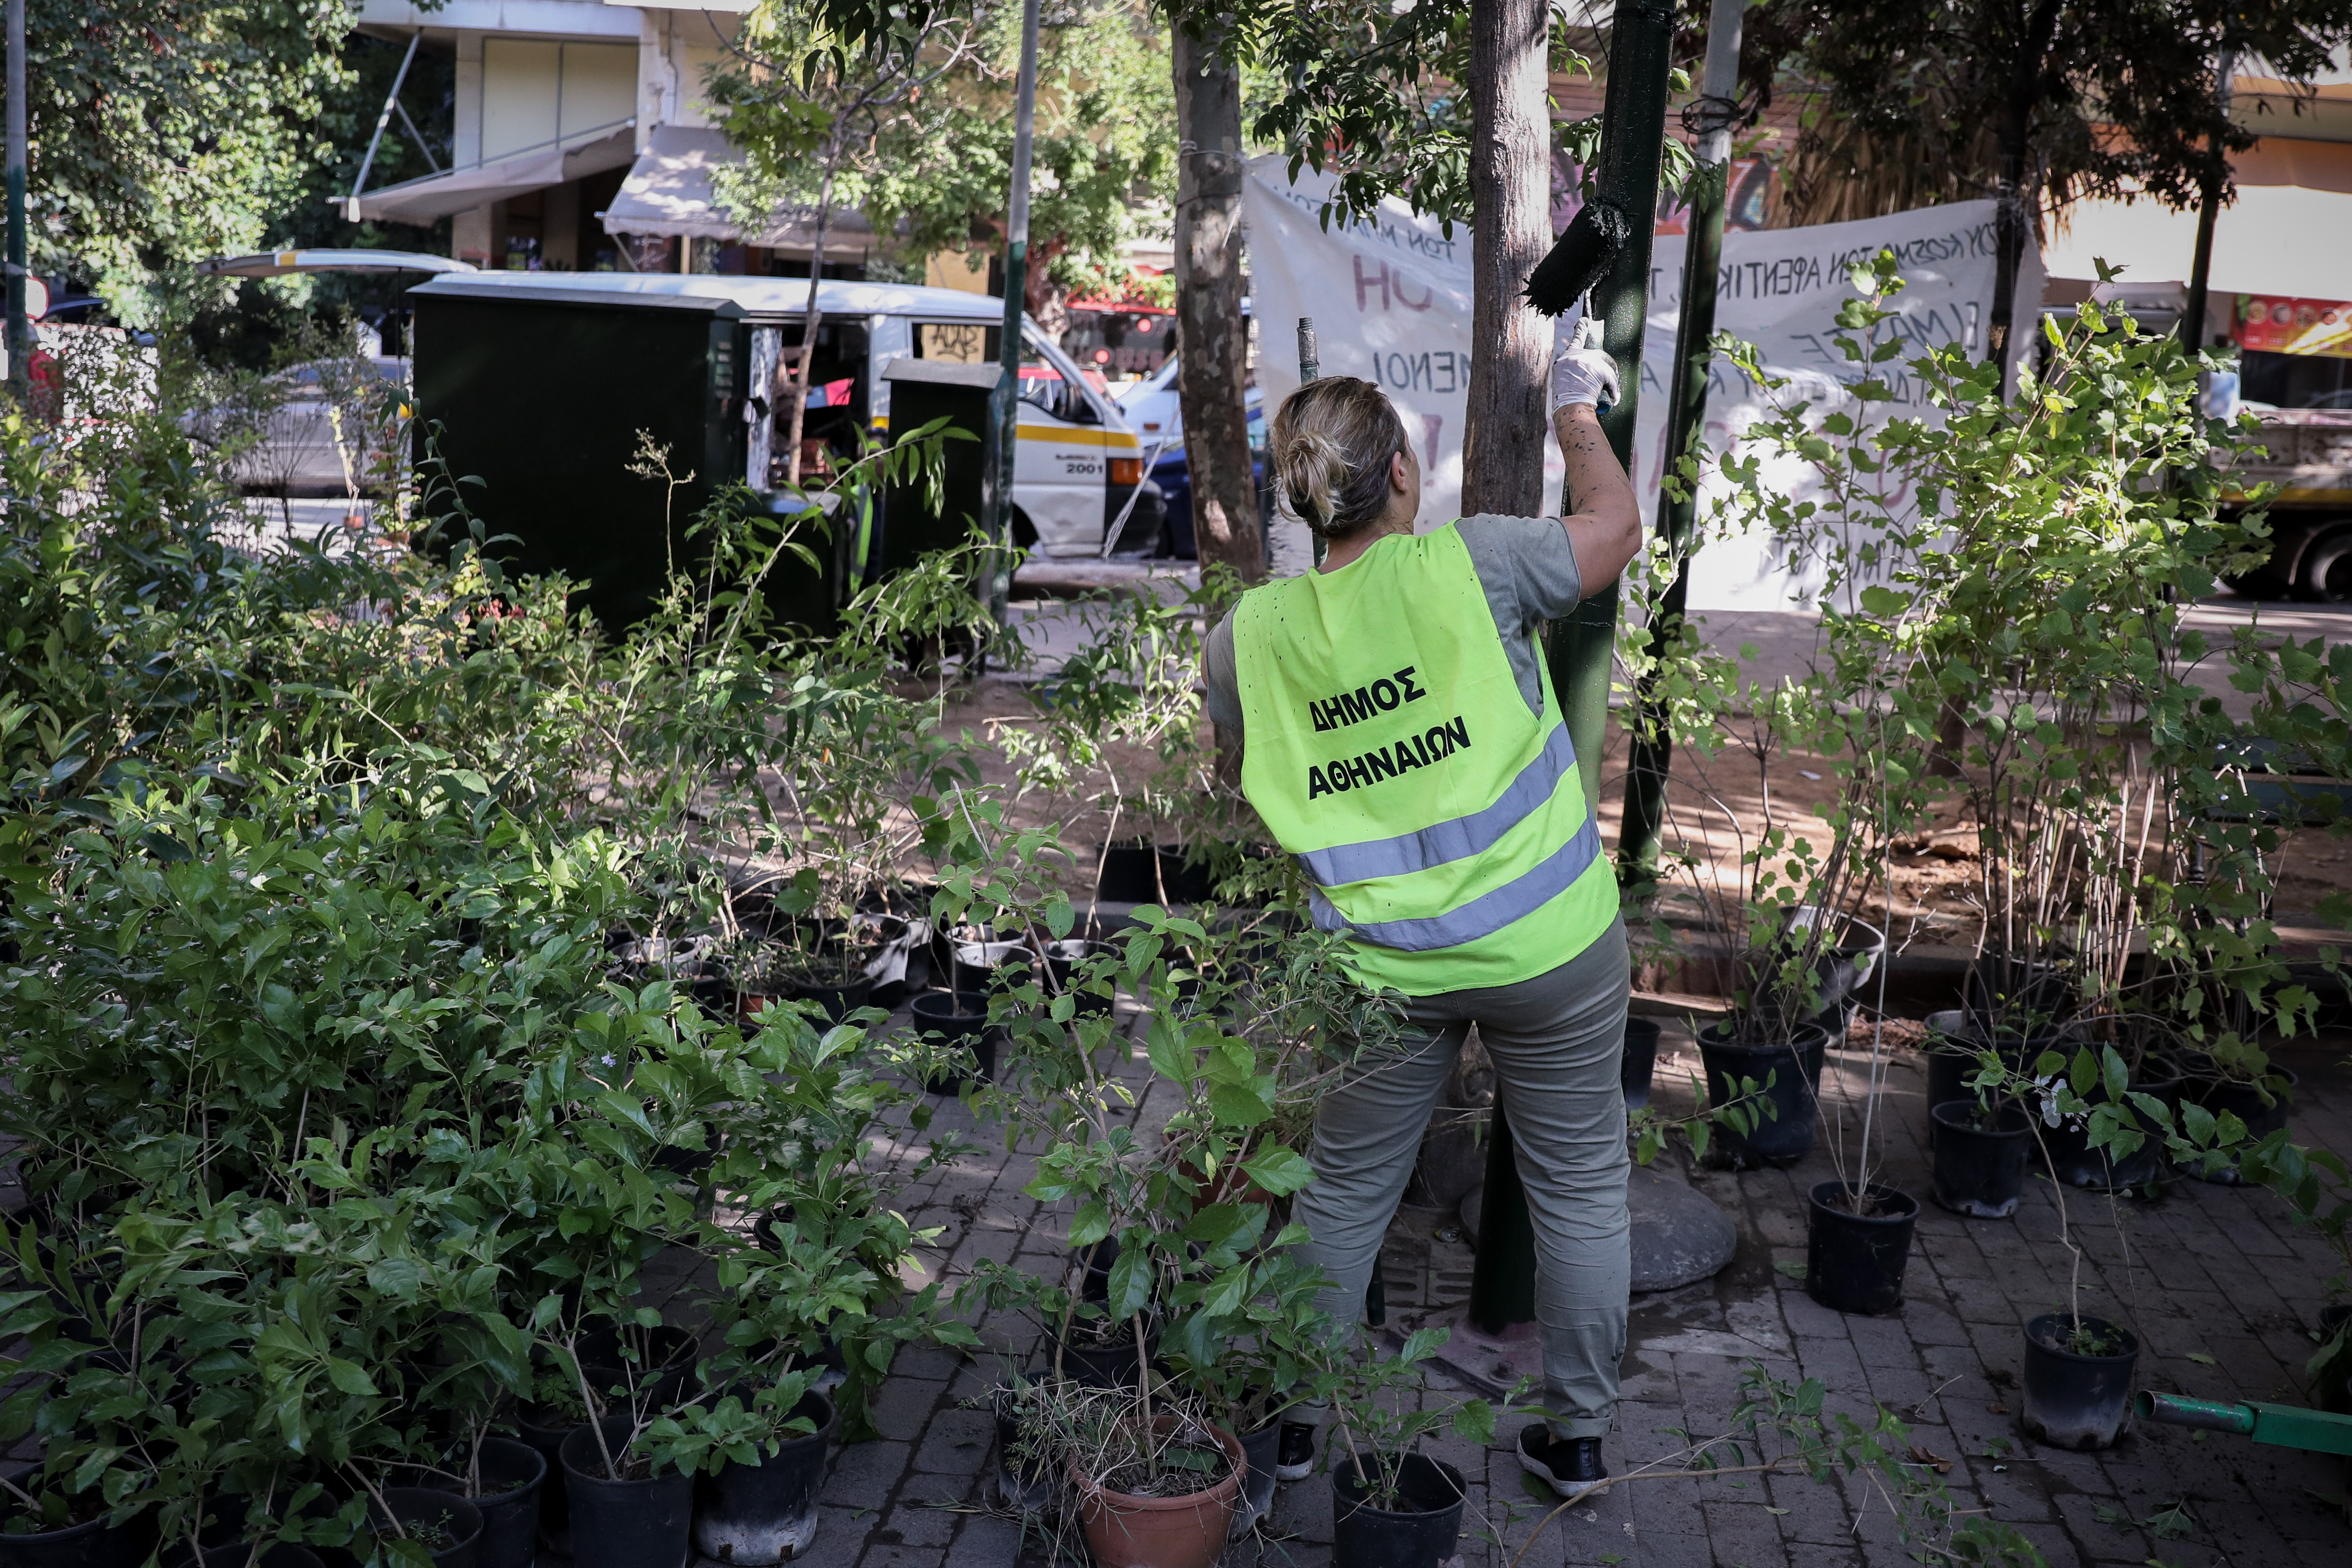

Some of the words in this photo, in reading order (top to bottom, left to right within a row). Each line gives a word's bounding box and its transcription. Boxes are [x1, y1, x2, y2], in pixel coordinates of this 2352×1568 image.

[1067, 463, 1103, 474] 2001
[1309, 665, 1427, 732] ΔΗΜΟΣ
[1309, 716, 1471, 800] ΑΘΗΝΑΙΩΝ
